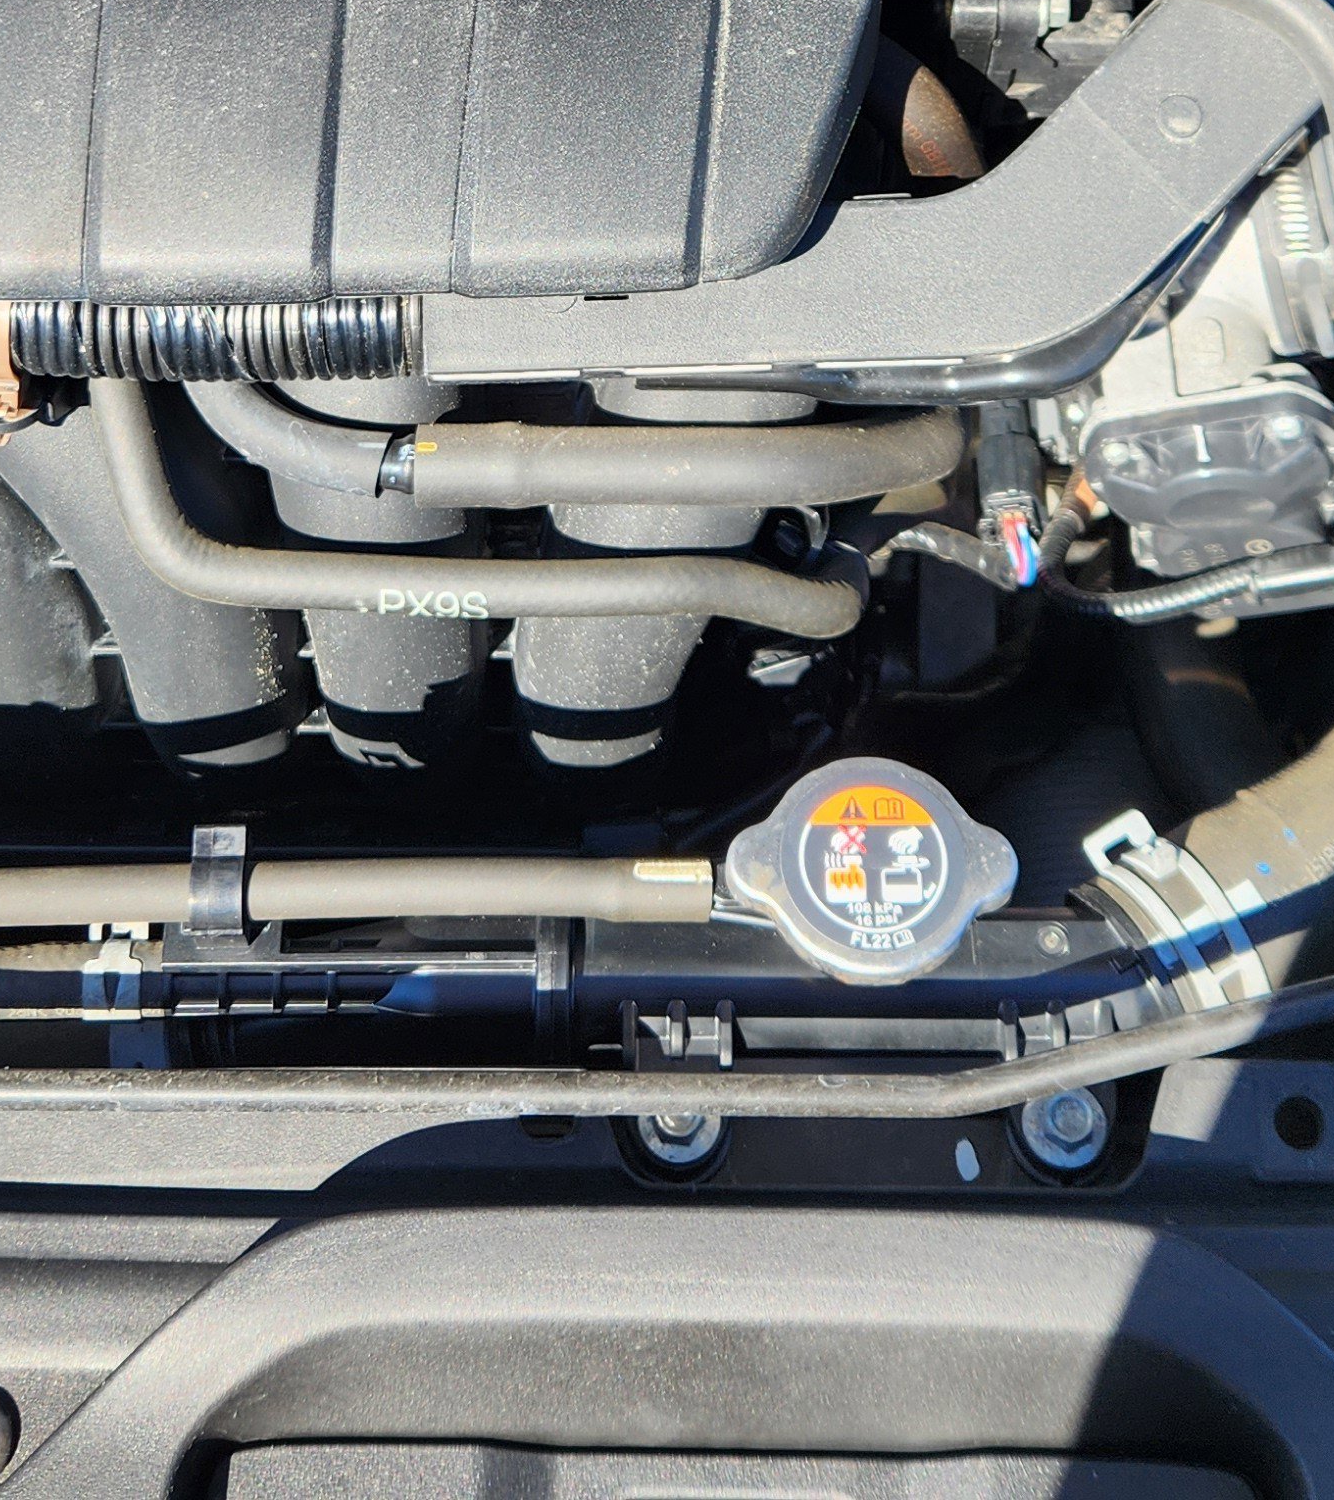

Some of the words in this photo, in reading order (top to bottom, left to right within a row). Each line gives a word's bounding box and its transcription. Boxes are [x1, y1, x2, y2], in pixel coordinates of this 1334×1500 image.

[846, 901, 873, 915] 108
[855, 914, 873, 927] 16
[850, 931, 892, 948] FL22
